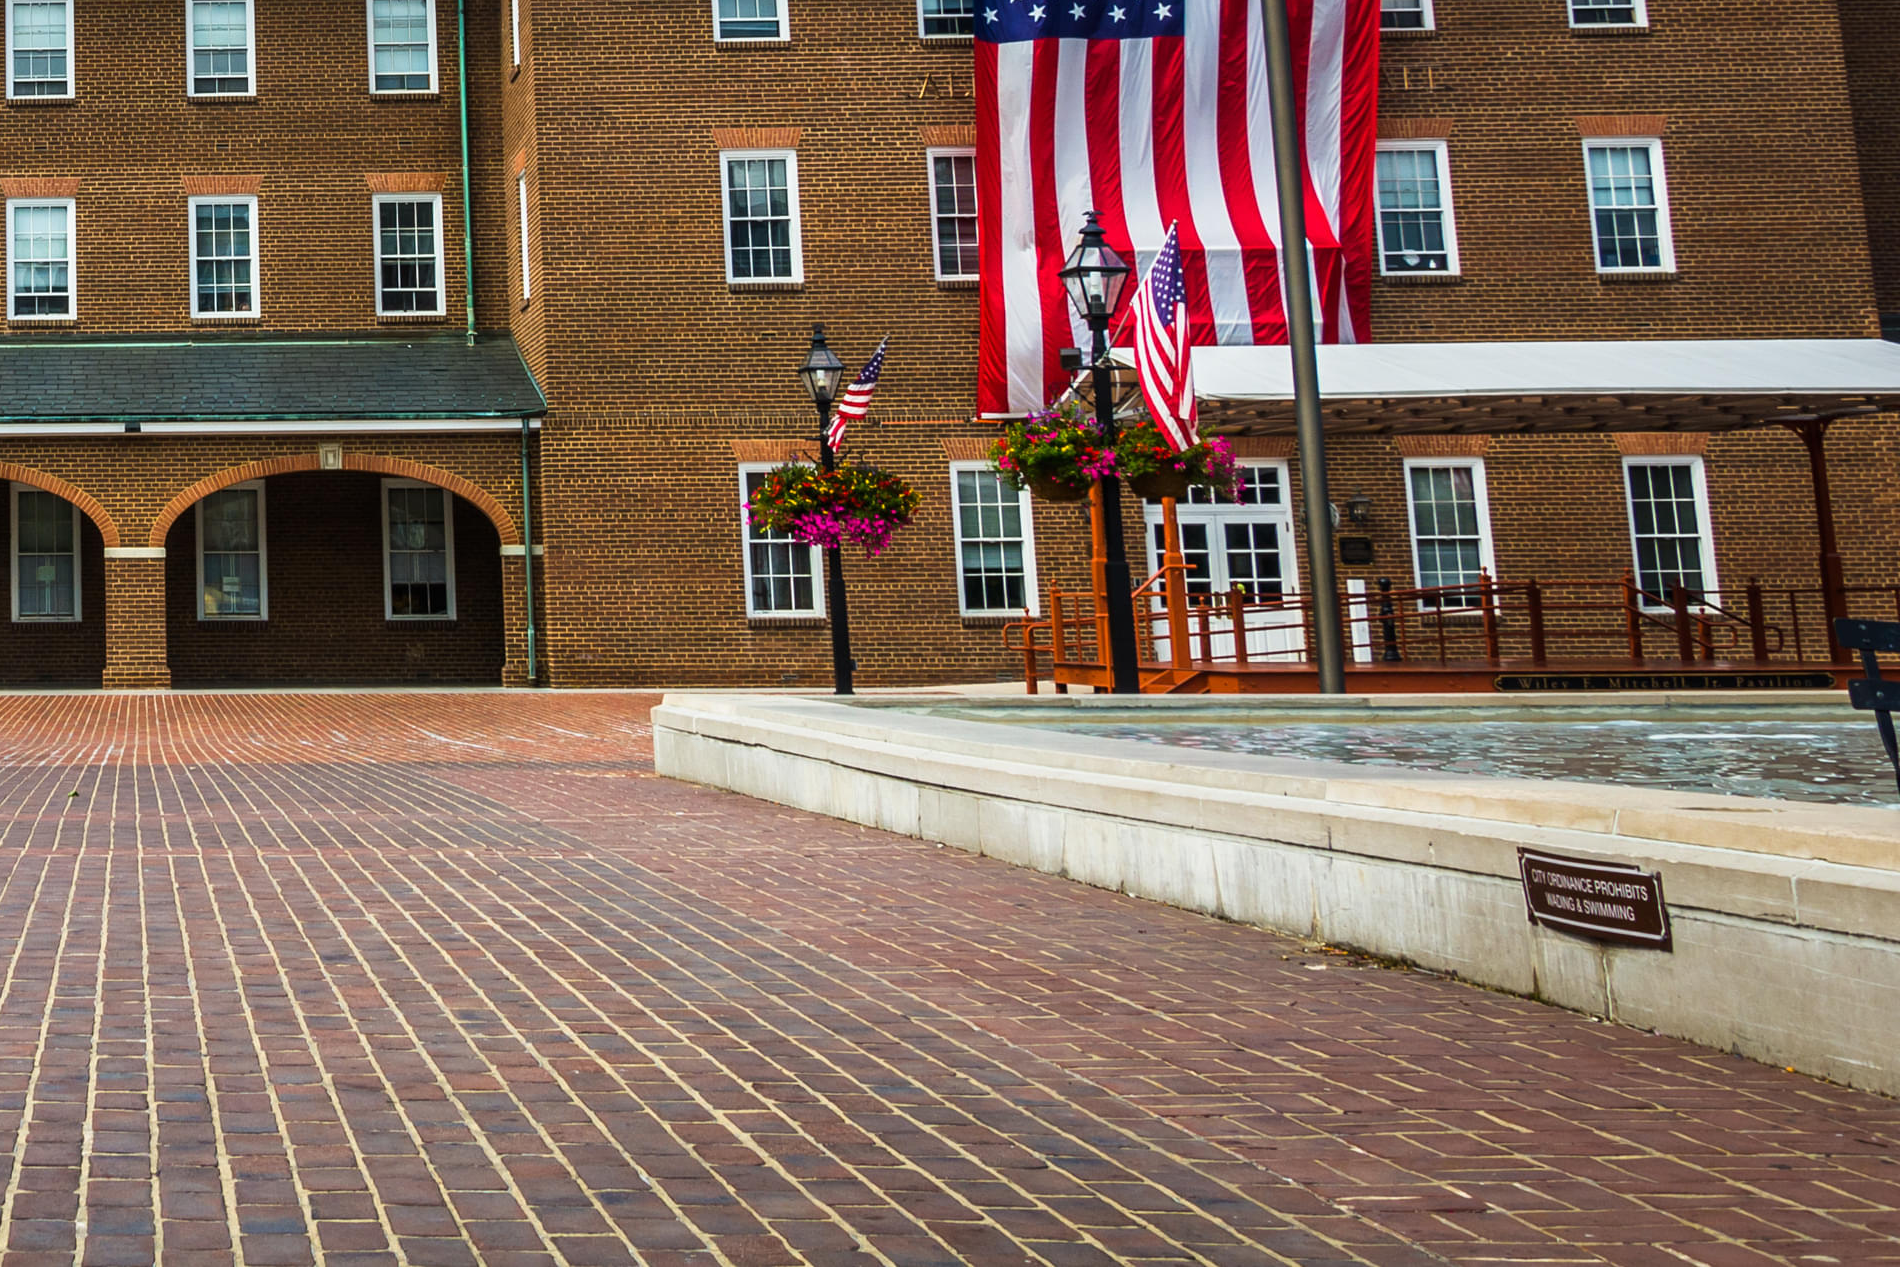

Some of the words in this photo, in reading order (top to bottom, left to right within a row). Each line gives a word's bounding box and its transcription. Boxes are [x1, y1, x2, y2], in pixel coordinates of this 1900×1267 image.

[1518, 677, 1569, 690] Wiley
[1736, 676, 1813, 688] Pavilion
[1531, 868, 1546, 884] CITY
[1546, 872, 1593, 893] ORDINANCE
[1594, 879, 1648, 901] PROHIBITS
[1545, 891, 1575, 912] WADING
[1575, 897, 1583, 913] &
[1583, 899, 1636, 921] SWIMMING
